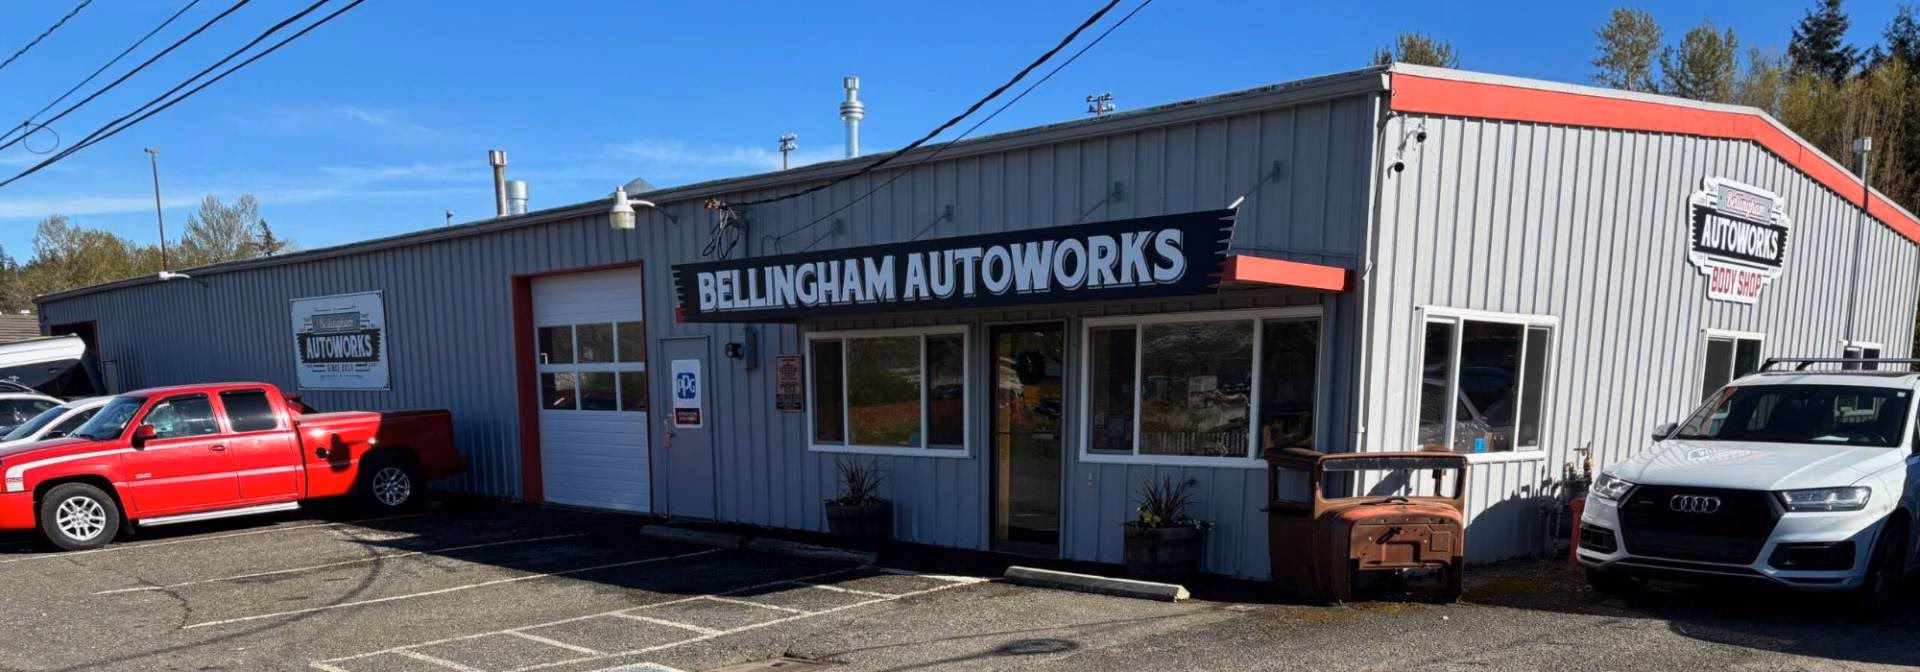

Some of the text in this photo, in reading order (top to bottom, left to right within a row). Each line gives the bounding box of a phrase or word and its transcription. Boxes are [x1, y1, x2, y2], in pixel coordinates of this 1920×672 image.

[1700, 213, 1779, 260] AUTOWORKS
[697, 228, 1186, 312] BELLINGHAM AUTOWORKS
[1711, 266, 1762, 298] BODY SHOP
[306, 334, 373, 359] AUTOWORKS
[677, 374, 696, 397] PPG
